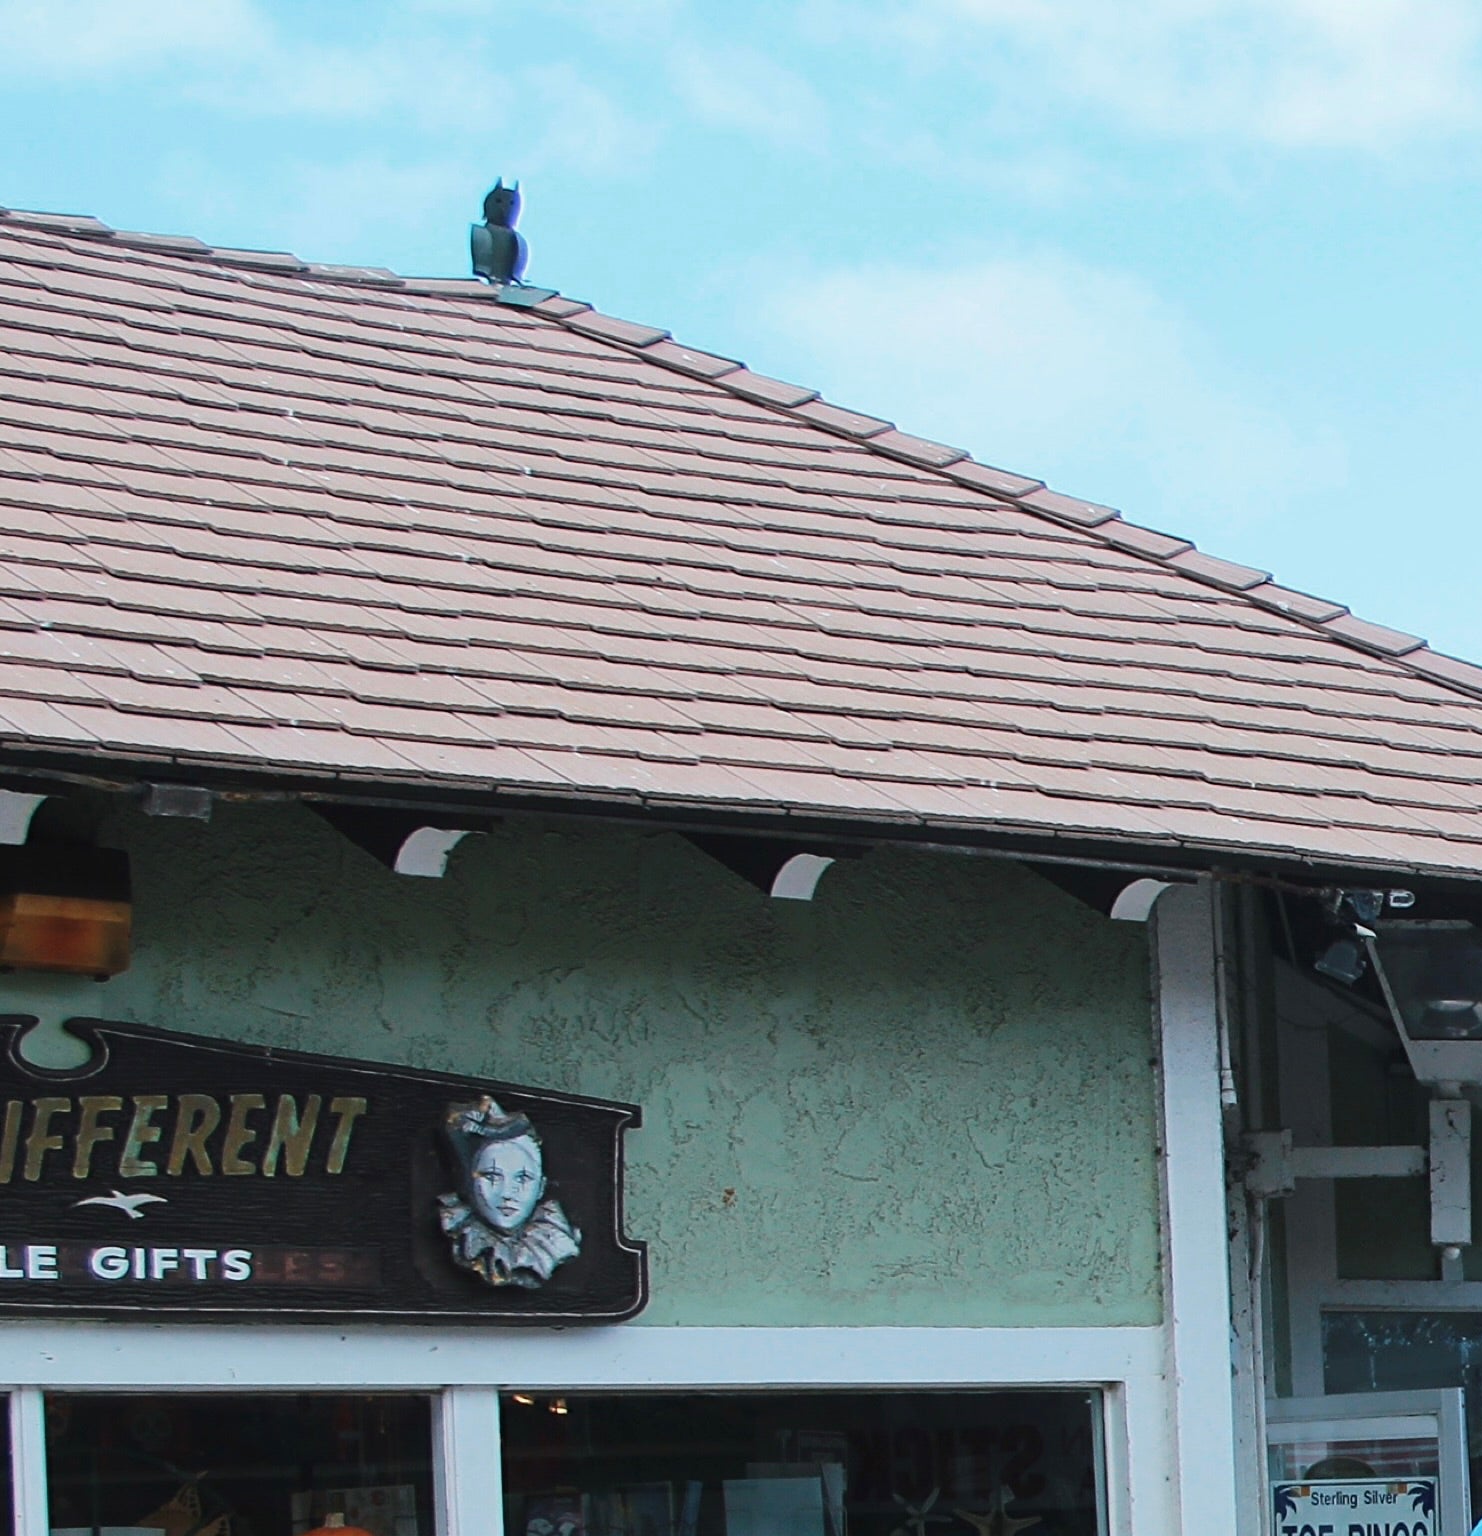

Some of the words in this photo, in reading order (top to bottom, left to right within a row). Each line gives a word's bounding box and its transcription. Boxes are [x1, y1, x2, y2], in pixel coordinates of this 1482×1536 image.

[91, 1246, 254, 1282] GIFTS
[1311, 1492, 1358, 1509] Sterling
[1363, 1490, 1399, 1505] Silver
